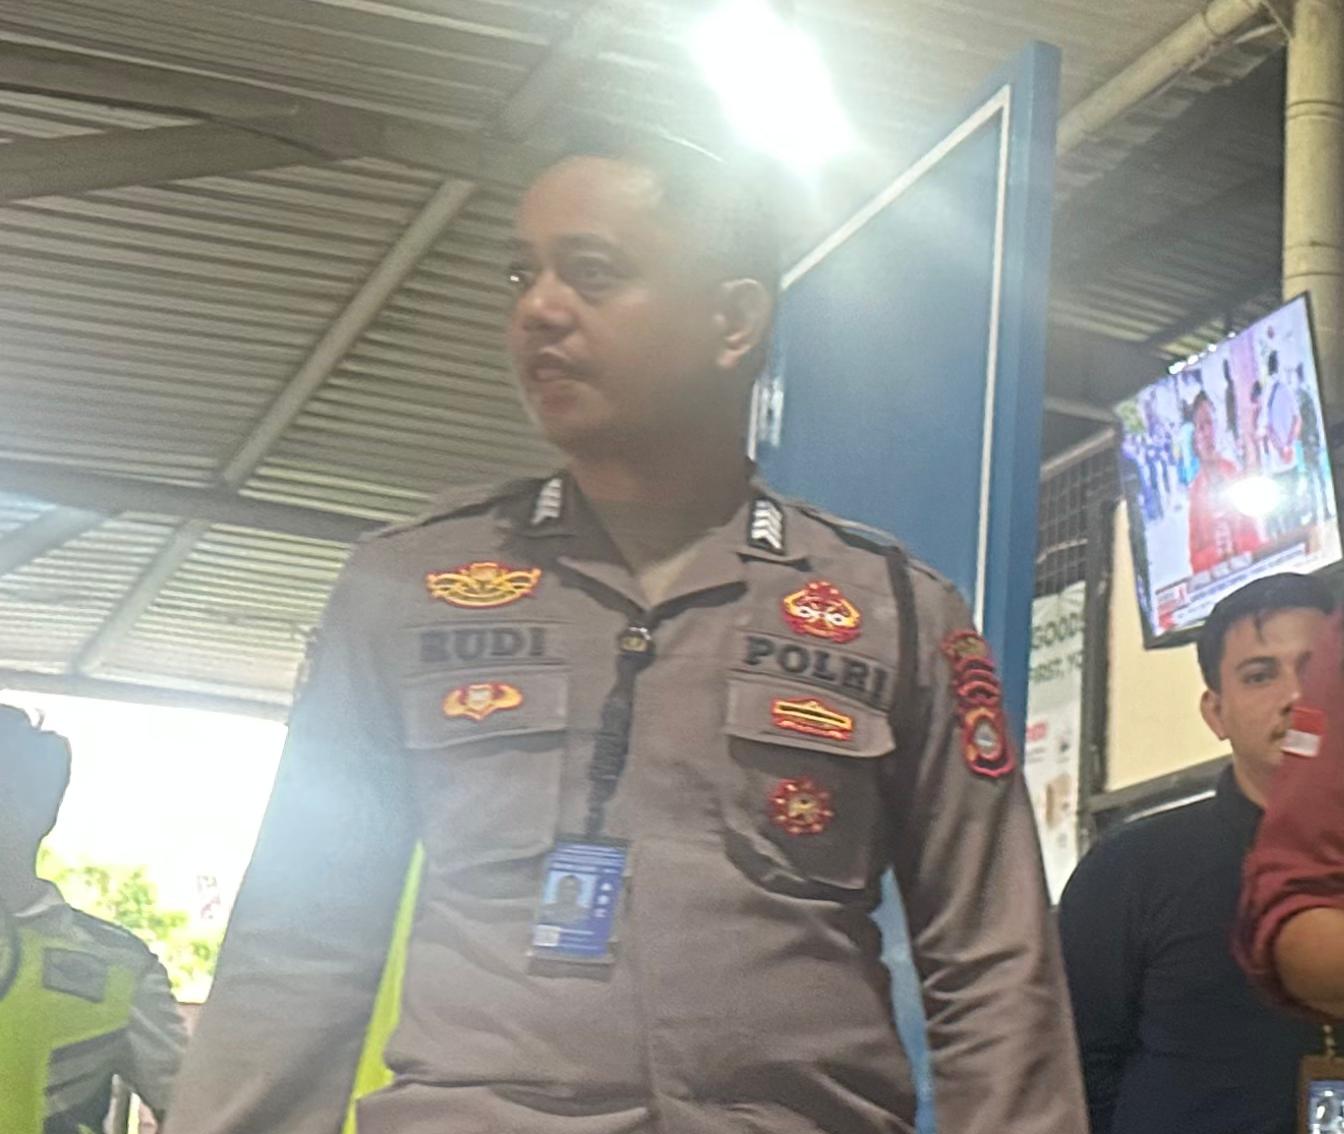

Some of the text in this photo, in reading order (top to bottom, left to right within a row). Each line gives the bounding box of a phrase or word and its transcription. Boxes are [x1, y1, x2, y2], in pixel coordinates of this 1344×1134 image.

[419, 627, 547, 664] RUDI
[1030, 612, 1083, 649] GOOD
[743, 634, 890, 701] POLRI
